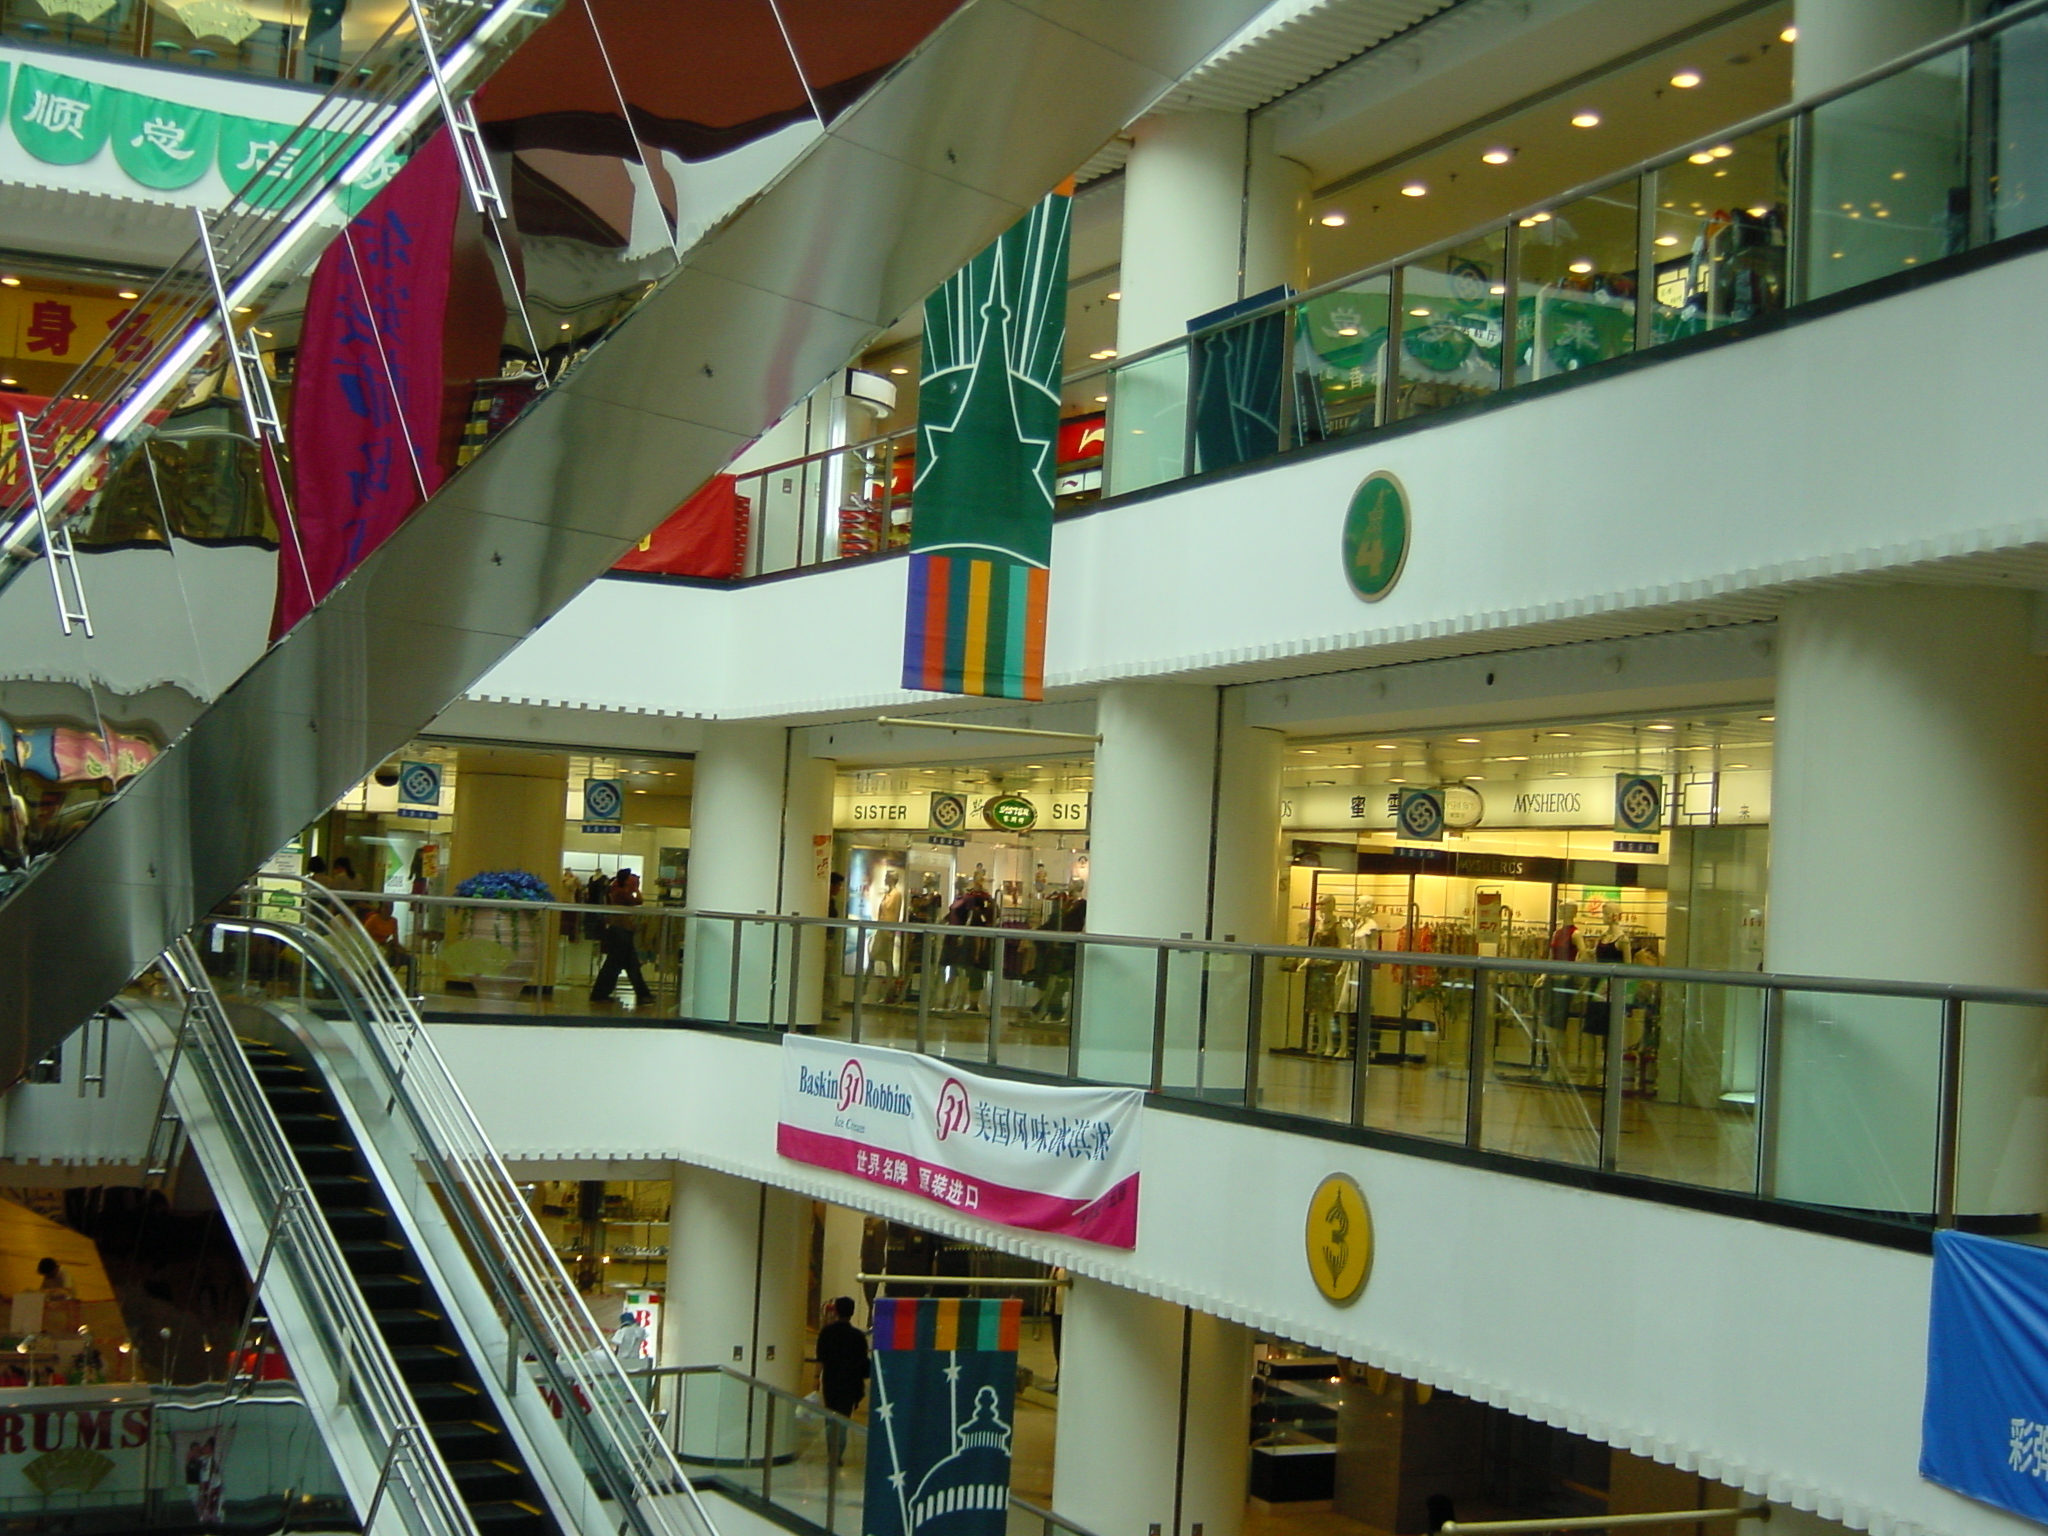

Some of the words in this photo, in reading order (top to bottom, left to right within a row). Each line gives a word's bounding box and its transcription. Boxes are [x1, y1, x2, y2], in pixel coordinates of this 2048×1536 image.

[854, 805, 907, 820] SISTER
[1052, 803, 1088, 820] SIS
[1513, 792, 1581, 814] MYSHEROS
[799, 1065, 839, 1101] Baskin
[837, 1071, 863, 1112] 31
[865, 1078, 912, 1118] Robbins
[936, 1085, 966, 1141] 31
[857, 1149, 908, 1185] 世界名牌
